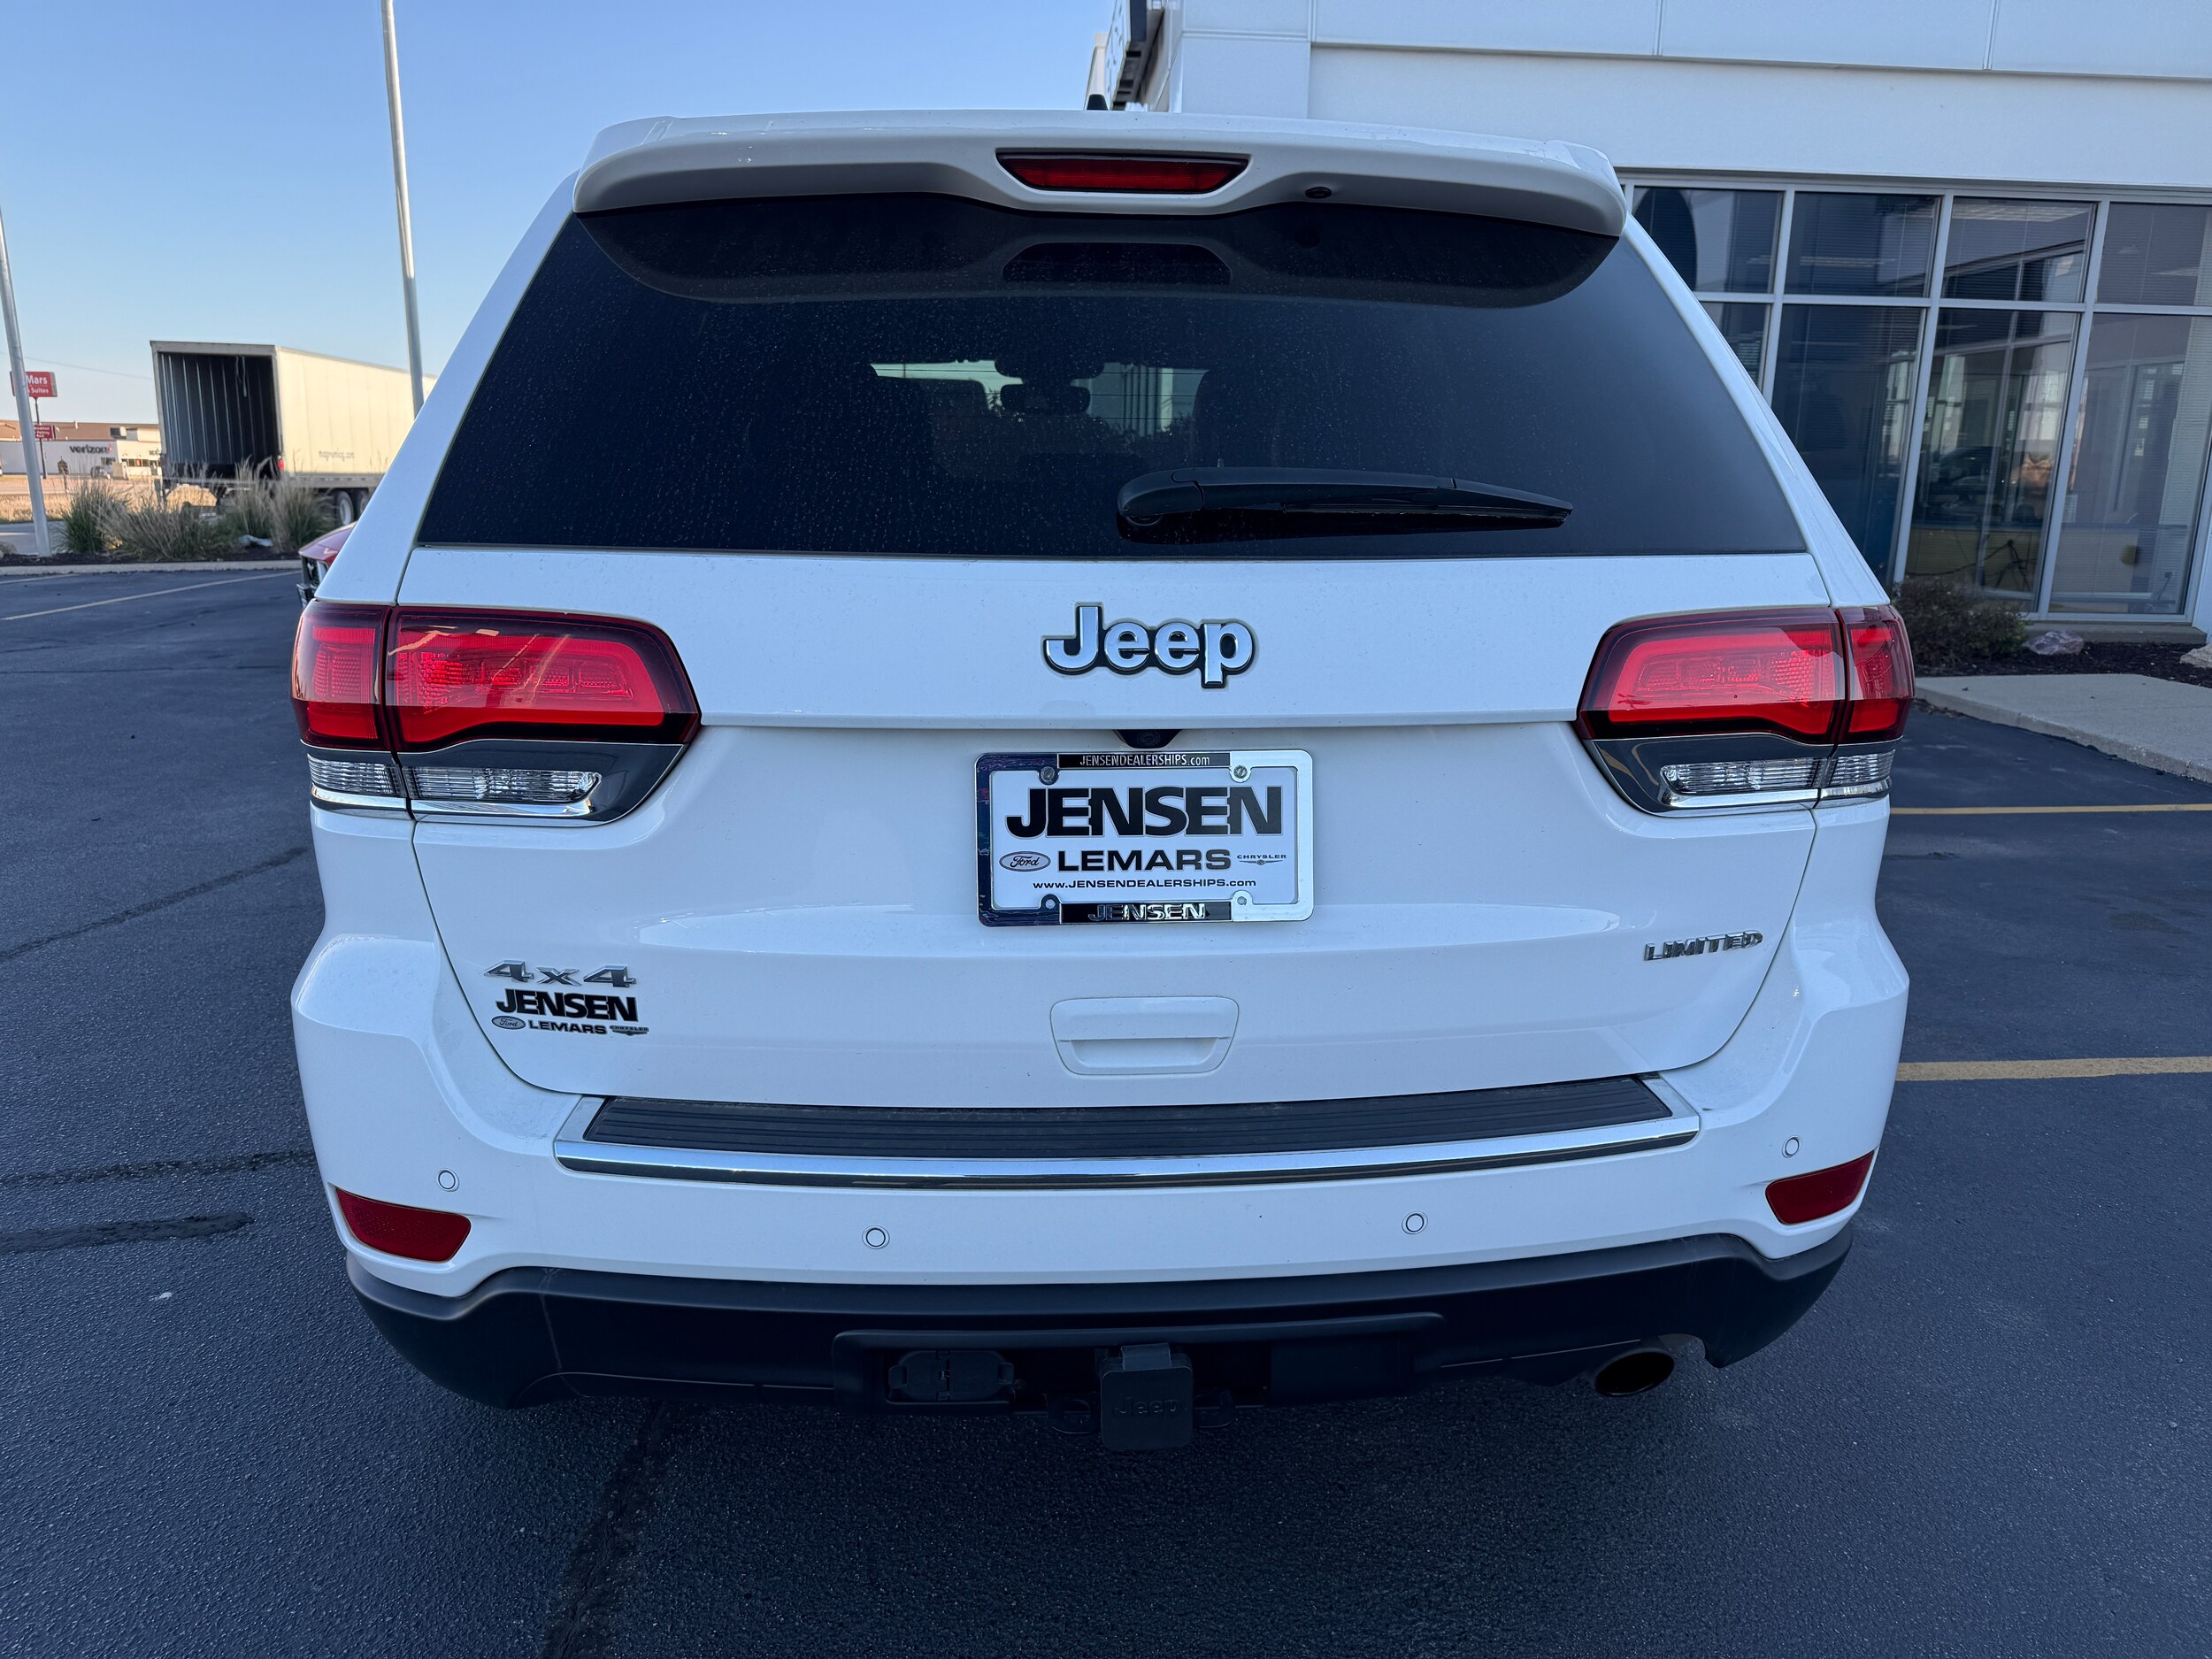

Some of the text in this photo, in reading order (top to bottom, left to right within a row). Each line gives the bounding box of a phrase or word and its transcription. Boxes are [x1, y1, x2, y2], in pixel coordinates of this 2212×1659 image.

[26, 375, 48, 385] Mars
[70, 444, 108, 454] verizon
[1043, 603, 1256, 689] Jeep
[1079, 754, 1210, 766] JENSENDEALERSHIPS.com
[1005, 785, 1283, 838] JENSEN
[1010, 855, 1041, 868] Ford
[1057, 849, 1231, 872] LEMARS
[1033, 879, 1257, 889] www.JENSENDEALERSHIPS.com
[1088, 902, 1207, 921] JENSEN
[1643, 930, 1763, 961] LIMITED
[483, 959, 637, 988] 4x4
[495, 987, 638, 1022] JENSEN
[498, 1018, 519, 1028] Ford
[528, 1019, 608, 1035] LEMARS
[1113, 1397, 1181, 1422] Jeep
